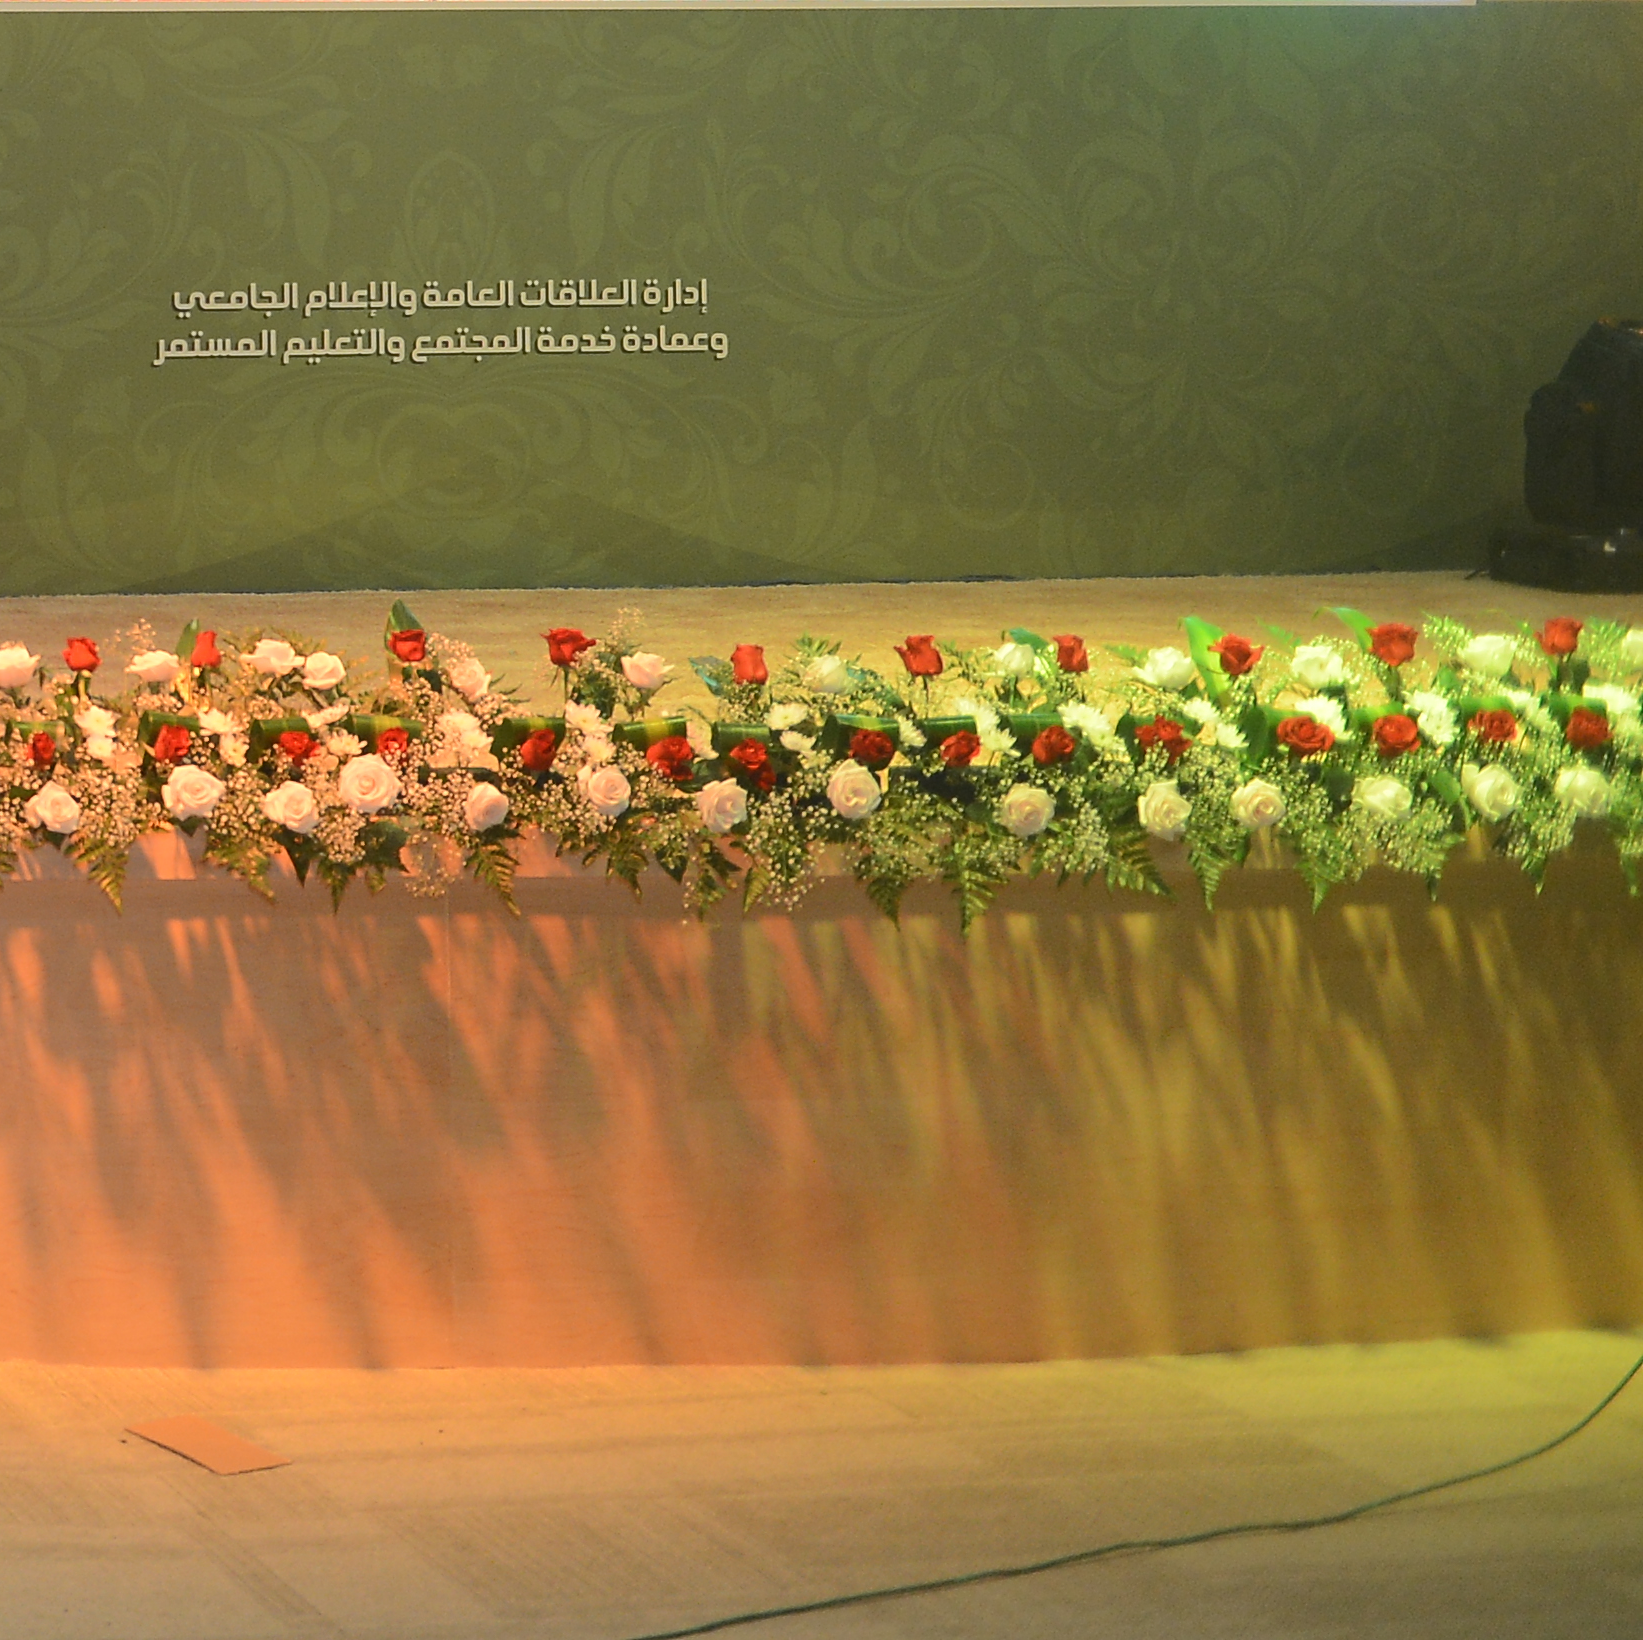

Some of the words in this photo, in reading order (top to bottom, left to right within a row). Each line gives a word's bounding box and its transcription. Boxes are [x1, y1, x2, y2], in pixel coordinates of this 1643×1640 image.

[172, 281, 299, 319] الجامعي
[304, 281, 418, 317] والإعلام
[423, 280, 514, 309] العامة
[520, 278, 638, 309] العلاقات
[641, 278, 709, 315] إدارة
[153, 328, 277, 366] المستمر
[284, 327, 406, 365] والتعليم
[411, 326, 531, 363] المجتمع
[537, 324, 617, 354] خدمة
[623, 325, 730, 360] وعمادة
